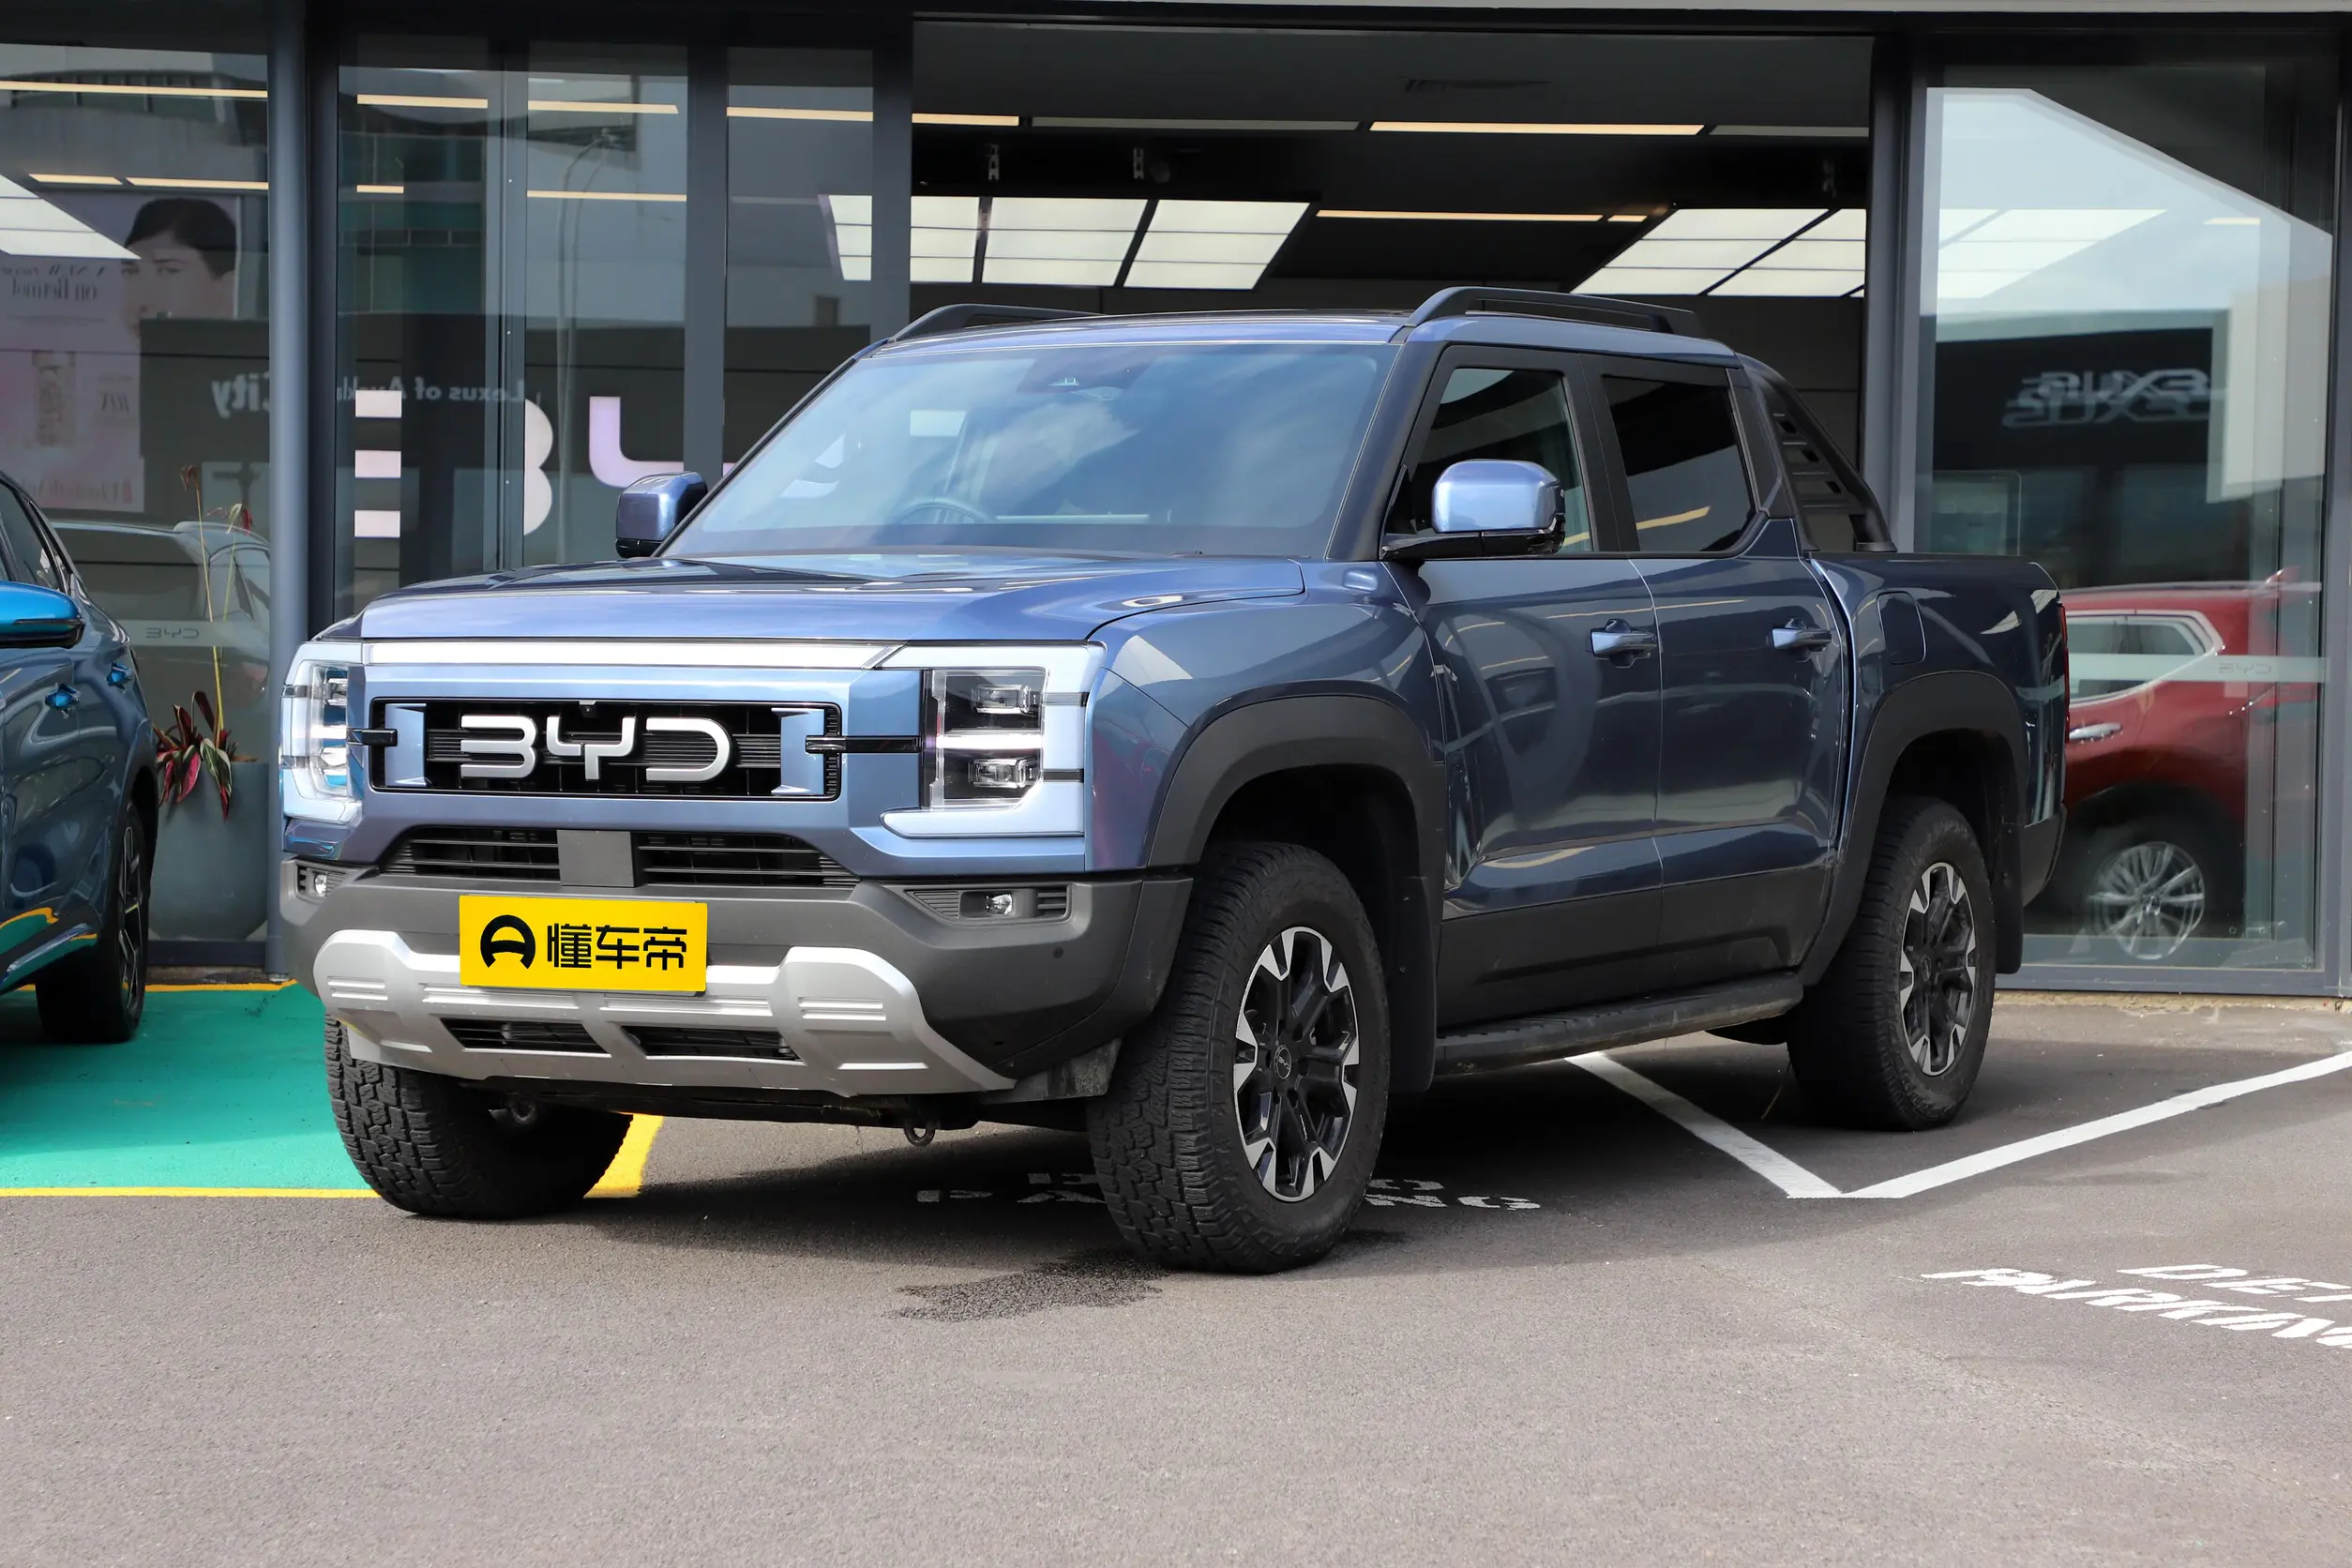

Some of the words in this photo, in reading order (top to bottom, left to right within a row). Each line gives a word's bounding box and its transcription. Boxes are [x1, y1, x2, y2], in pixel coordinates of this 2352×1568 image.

[145, 627, 200, 640] BYD
[2218, 662, 2272, 674] BYD
[460, 715, 731, 782] BYD
[547, 922, 687, 971] 懂车帝
